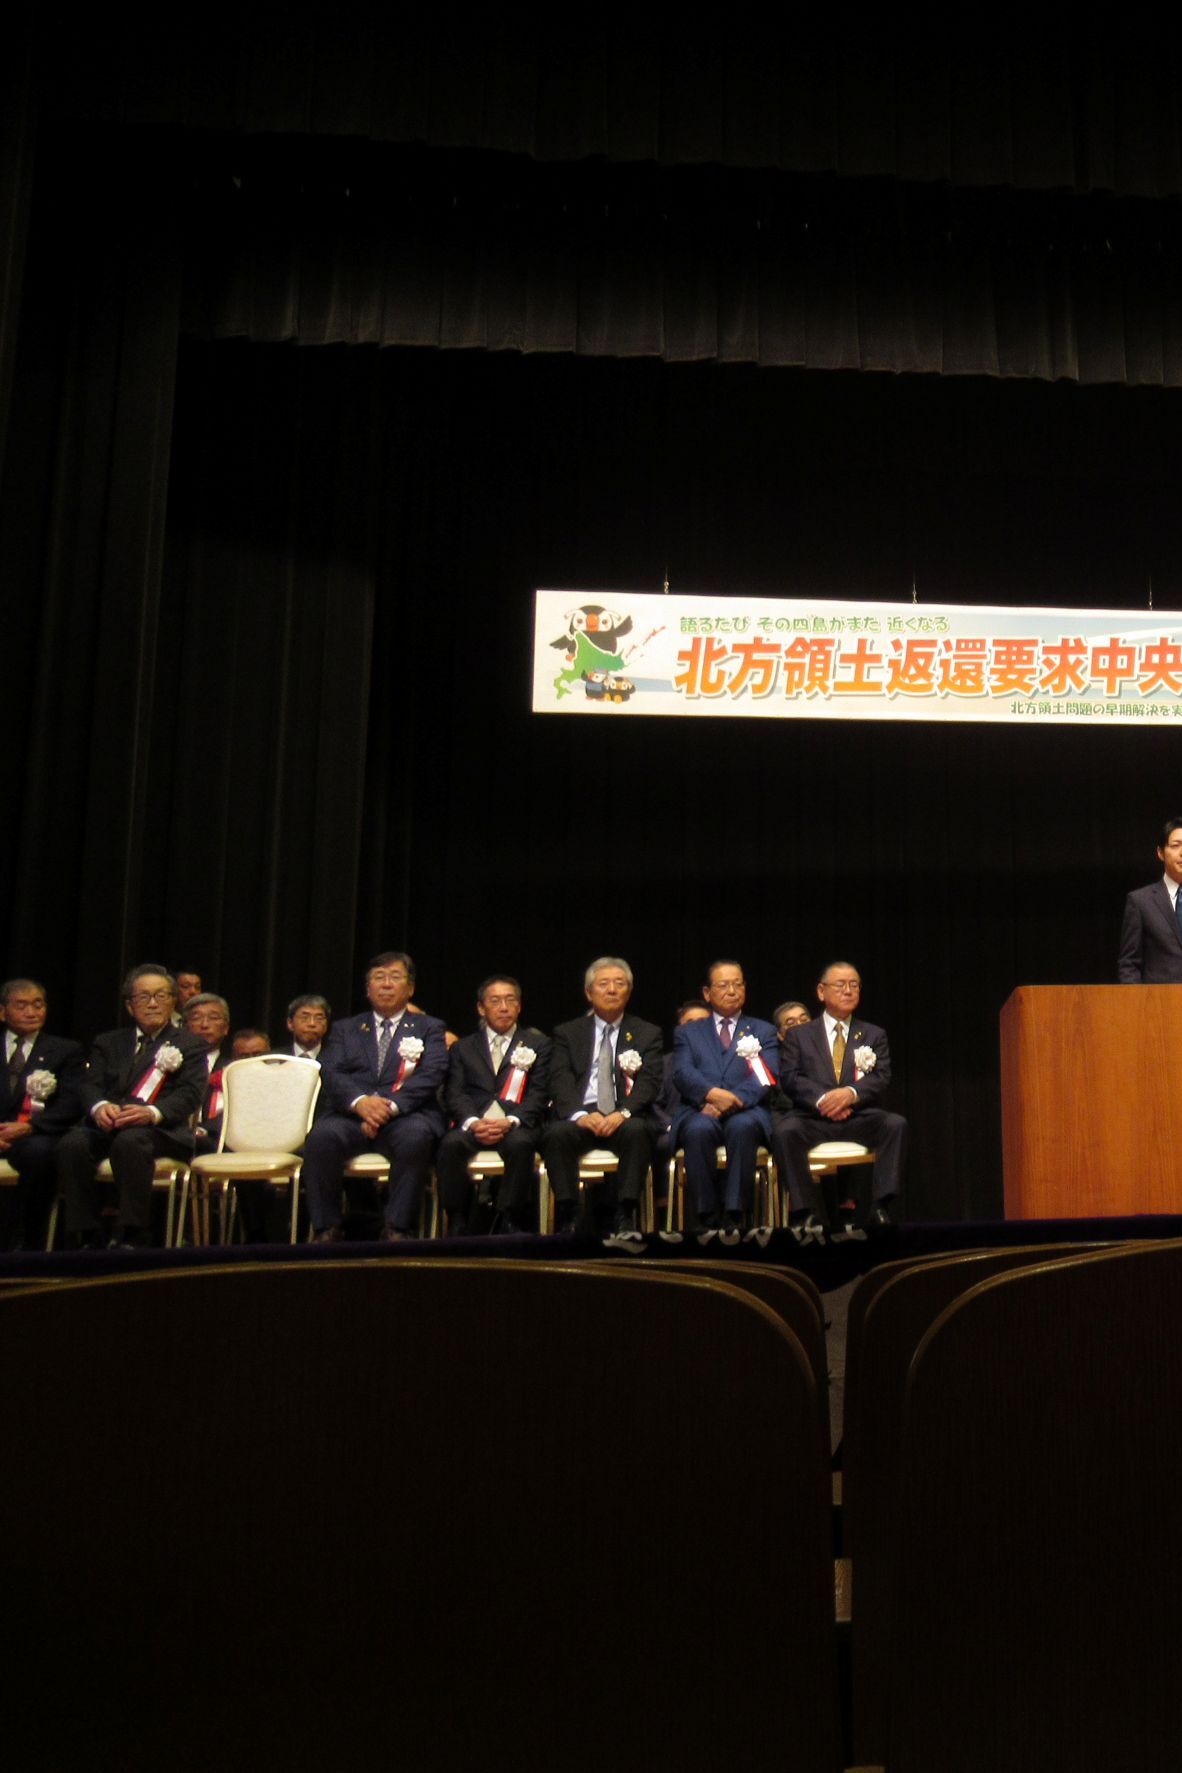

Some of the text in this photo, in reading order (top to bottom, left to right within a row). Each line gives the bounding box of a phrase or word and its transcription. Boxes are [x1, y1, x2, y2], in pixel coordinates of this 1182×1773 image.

[680, 616, 949, 633] 語るたび その四島がまた 近くなる
